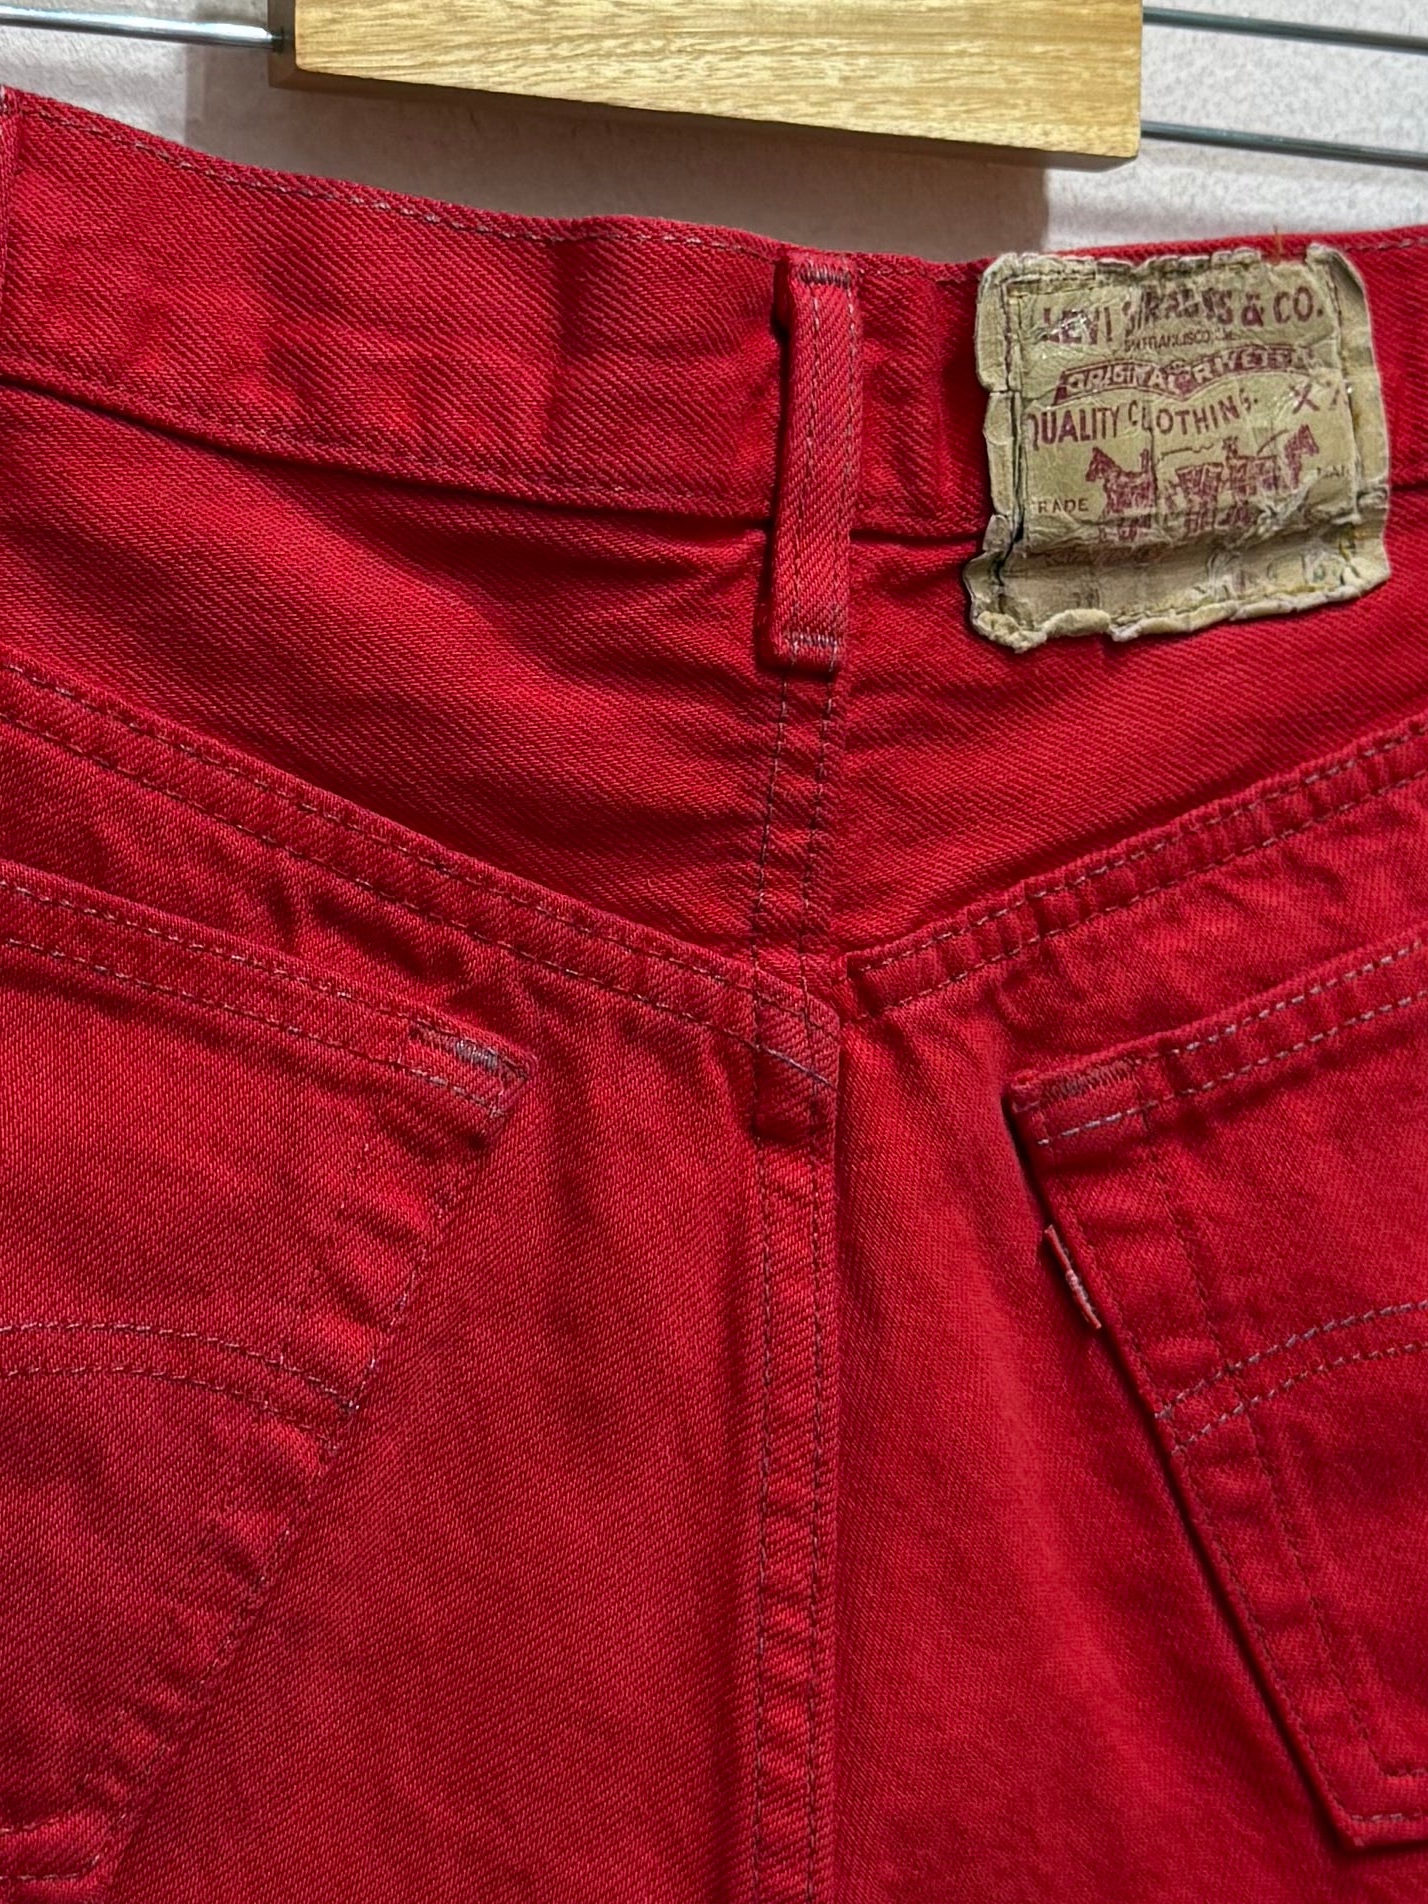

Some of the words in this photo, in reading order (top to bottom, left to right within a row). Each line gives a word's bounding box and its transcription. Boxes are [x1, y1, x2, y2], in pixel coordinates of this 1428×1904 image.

[1241, 292, 1265, 328] &
[1273, 285, 1324, 324] CO.
[1032, 495, 1090, 514] RADE
